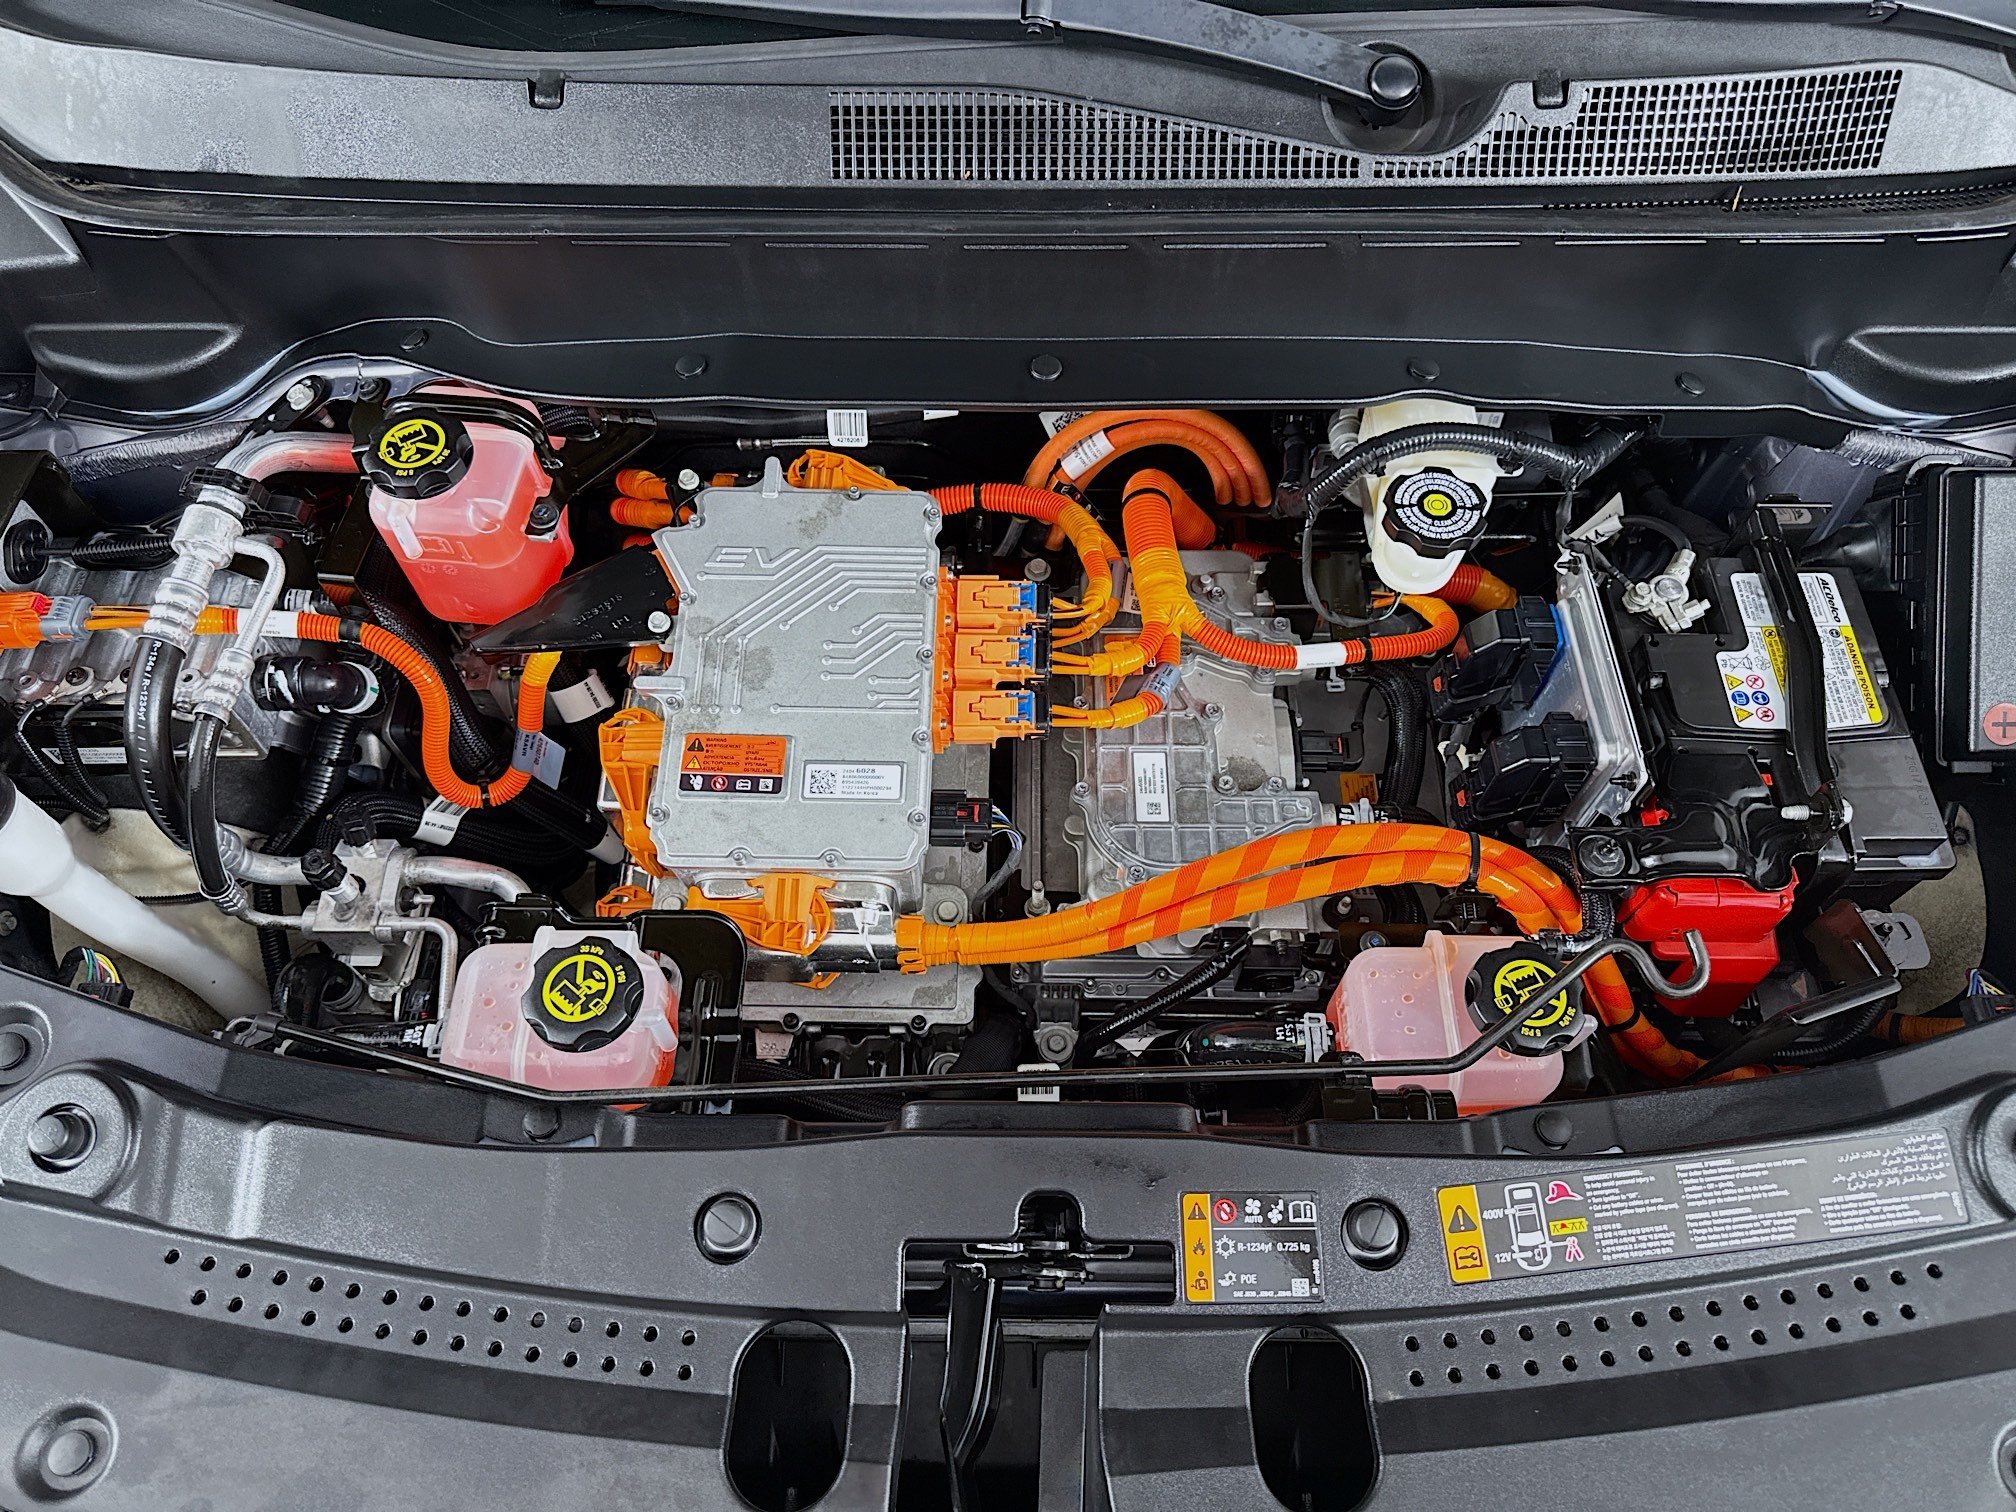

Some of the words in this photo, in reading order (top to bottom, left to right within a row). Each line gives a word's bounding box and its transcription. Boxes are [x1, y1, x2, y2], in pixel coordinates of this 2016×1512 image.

[1418, 528, 1436, 538] FROM
[704, 545, 800, 569] EV
[1819, 577, 1841, 623] ACDelco
[1741, 598, 1751, 620] GERMANY
[137, 678, 151, 721] R-1234yf
[579, 944, 590, 953] 35
[590, 945, 605, 956] kPa
[614, 964, 624, 972] 5
[617, 971, 627, 984] PSI
[1566, 1006, 1577, 1017] 35
[1275, 1027, 1285, 1041] LH
[1284, 1023, 1296, 1044] SGT
[1520, 1026, 1535, 1037] PSI
[1534, 1028, 1542, 1037] 5
[1244, 1215, 1264, 1224] AUTO
[1482, 1208, 1505, 1221] 400V
[1237, 1242, 1273, 1254] R-1234yf
[1276, 1242, 1299, 1252] 0.725
[1299, 1242, 1311, 1254] kg
[1494, 1251, 1512, 1264] 12V
[1240, 1274, 1258, 1284] POE
